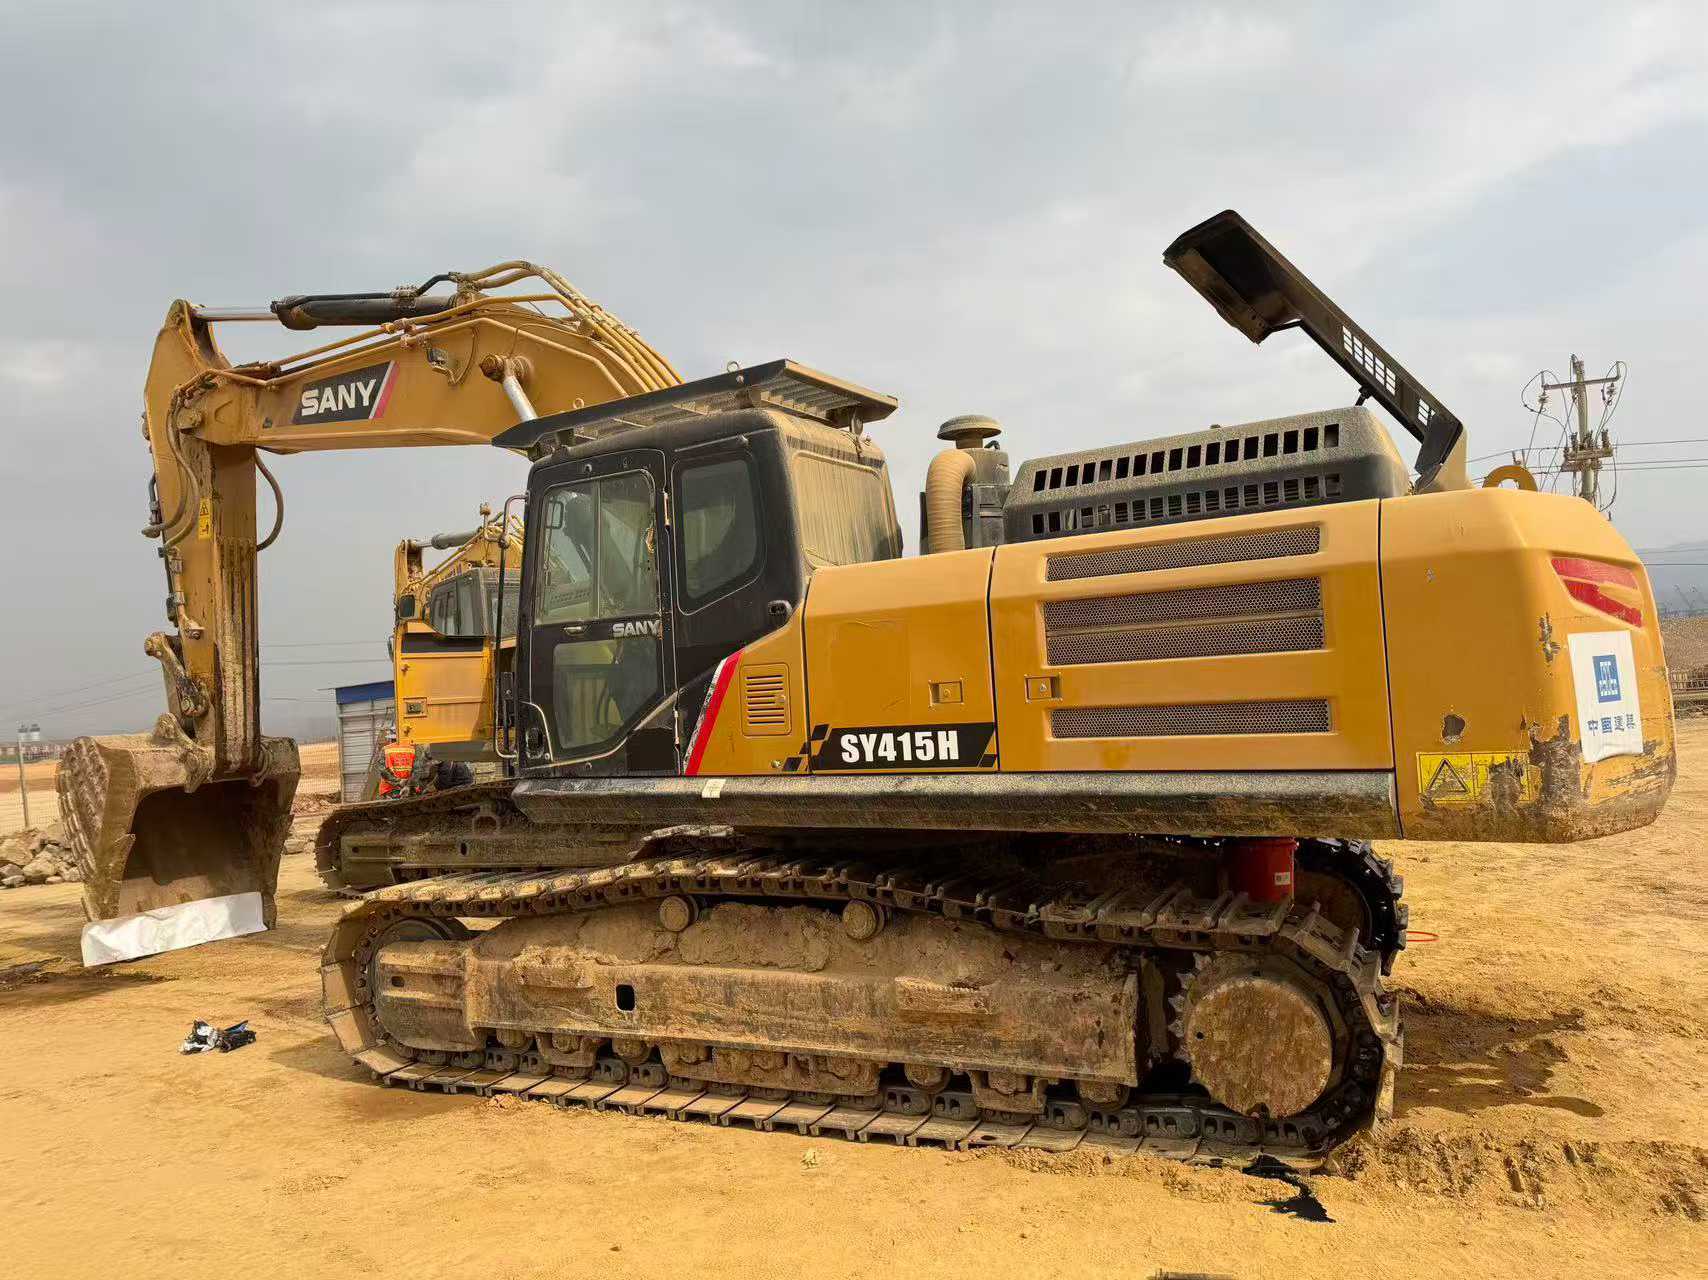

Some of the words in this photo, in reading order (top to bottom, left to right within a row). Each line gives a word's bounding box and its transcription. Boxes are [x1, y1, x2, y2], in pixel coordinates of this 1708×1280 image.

[301, 379, 377, 416] SANY
[612, 620, 660, 638] SANY
[840, 730, 959, 763] SY415H
